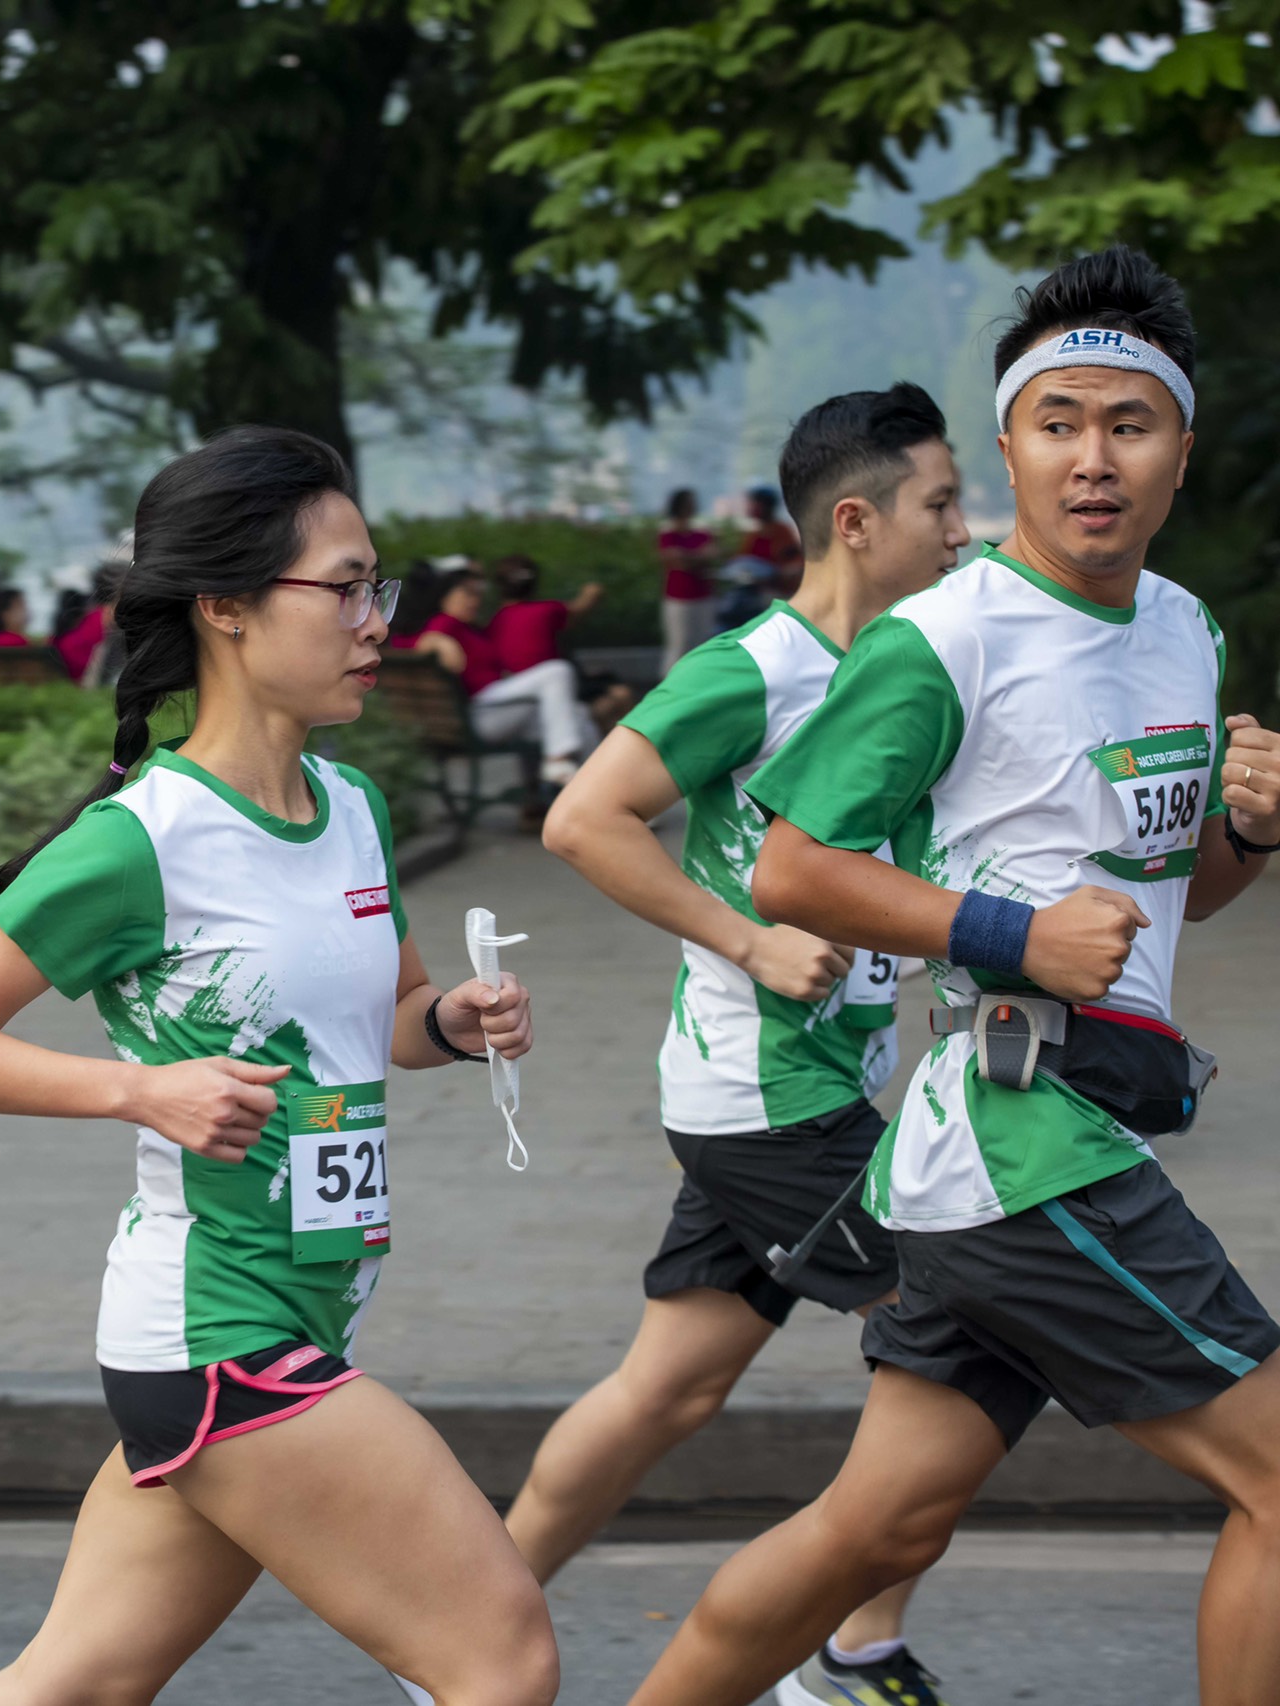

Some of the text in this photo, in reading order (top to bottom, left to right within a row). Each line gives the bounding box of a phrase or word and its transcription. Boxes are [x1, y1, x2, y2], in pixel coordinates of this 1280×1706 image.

[1061, 330, 1123, 347] ASH
[1119, 346, 1140, 359] Pro
[1137, 754, 1155, 768] RACE
[1152, 751, 1167, 766] FOR
[1166, 749, 1186, 764] GREEN
[1185, 747, 1196, 761] LIFE
[1133, 779, 1200, 839] 5198
[308, 952, 371, 977] adidas
[868, 952, 898, 986] 5
[346, 1104, 365, 1120] RACE
